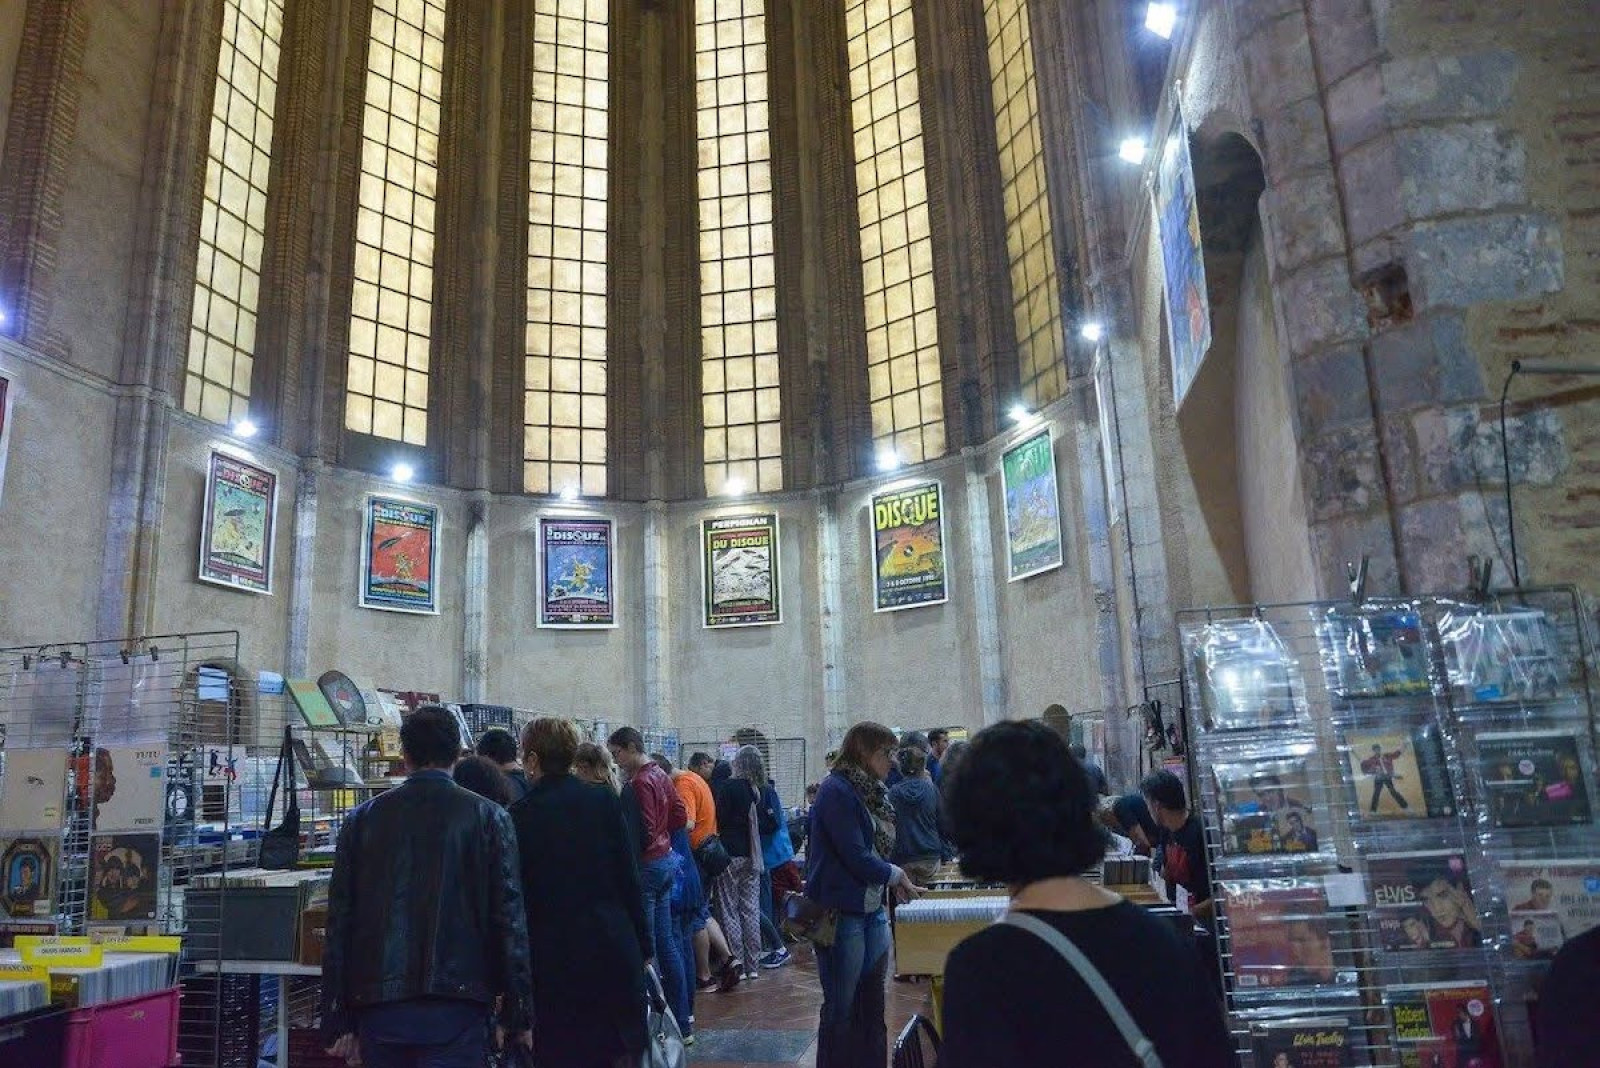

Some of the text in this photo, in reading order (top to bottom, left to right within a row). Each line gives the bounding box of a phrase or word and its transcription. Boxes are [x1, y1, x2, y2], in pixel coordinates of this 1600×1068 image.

[382, 508, 427, 524] DISQUE
[875, 492, 938, 530] DISQUE
[712, 518, 768, 529] PERPIGNAN
[554, 531, 601, 542] DISQUE
[712, 540, 728, 549] DU
[731, 535, 769, 548] DISQUE
[1227, 891, 1263, 908] ELVIS
[1375, 884, 1416, 904] ELVIS
